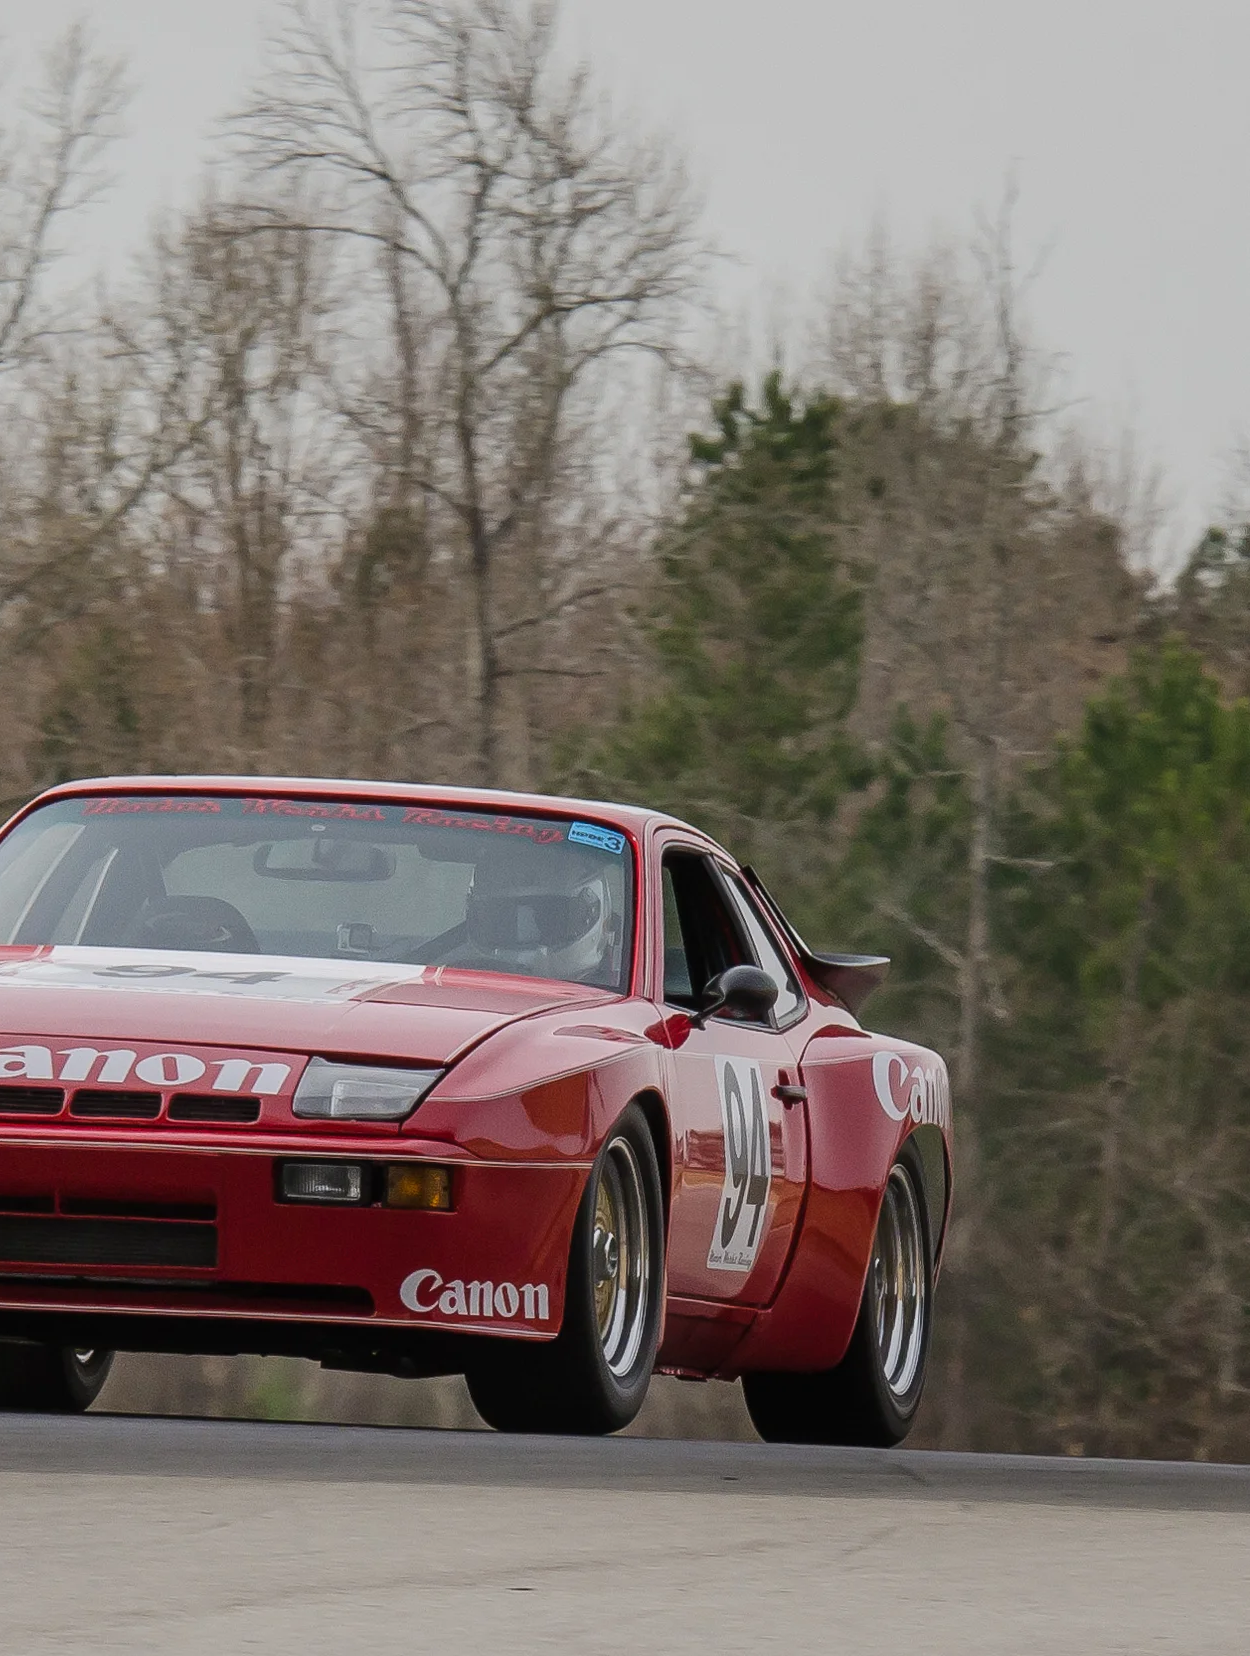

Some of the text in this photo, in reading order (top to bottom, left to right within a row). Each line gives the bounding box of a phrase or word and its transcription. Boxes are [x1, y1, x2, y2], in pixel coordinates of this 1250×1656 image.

[604, 836, 622, 851] 3
[92, 964, 293, 985] 94
[721, 1060, 768, 1249] 94
[399, 1268, 550, 1320] Canon
